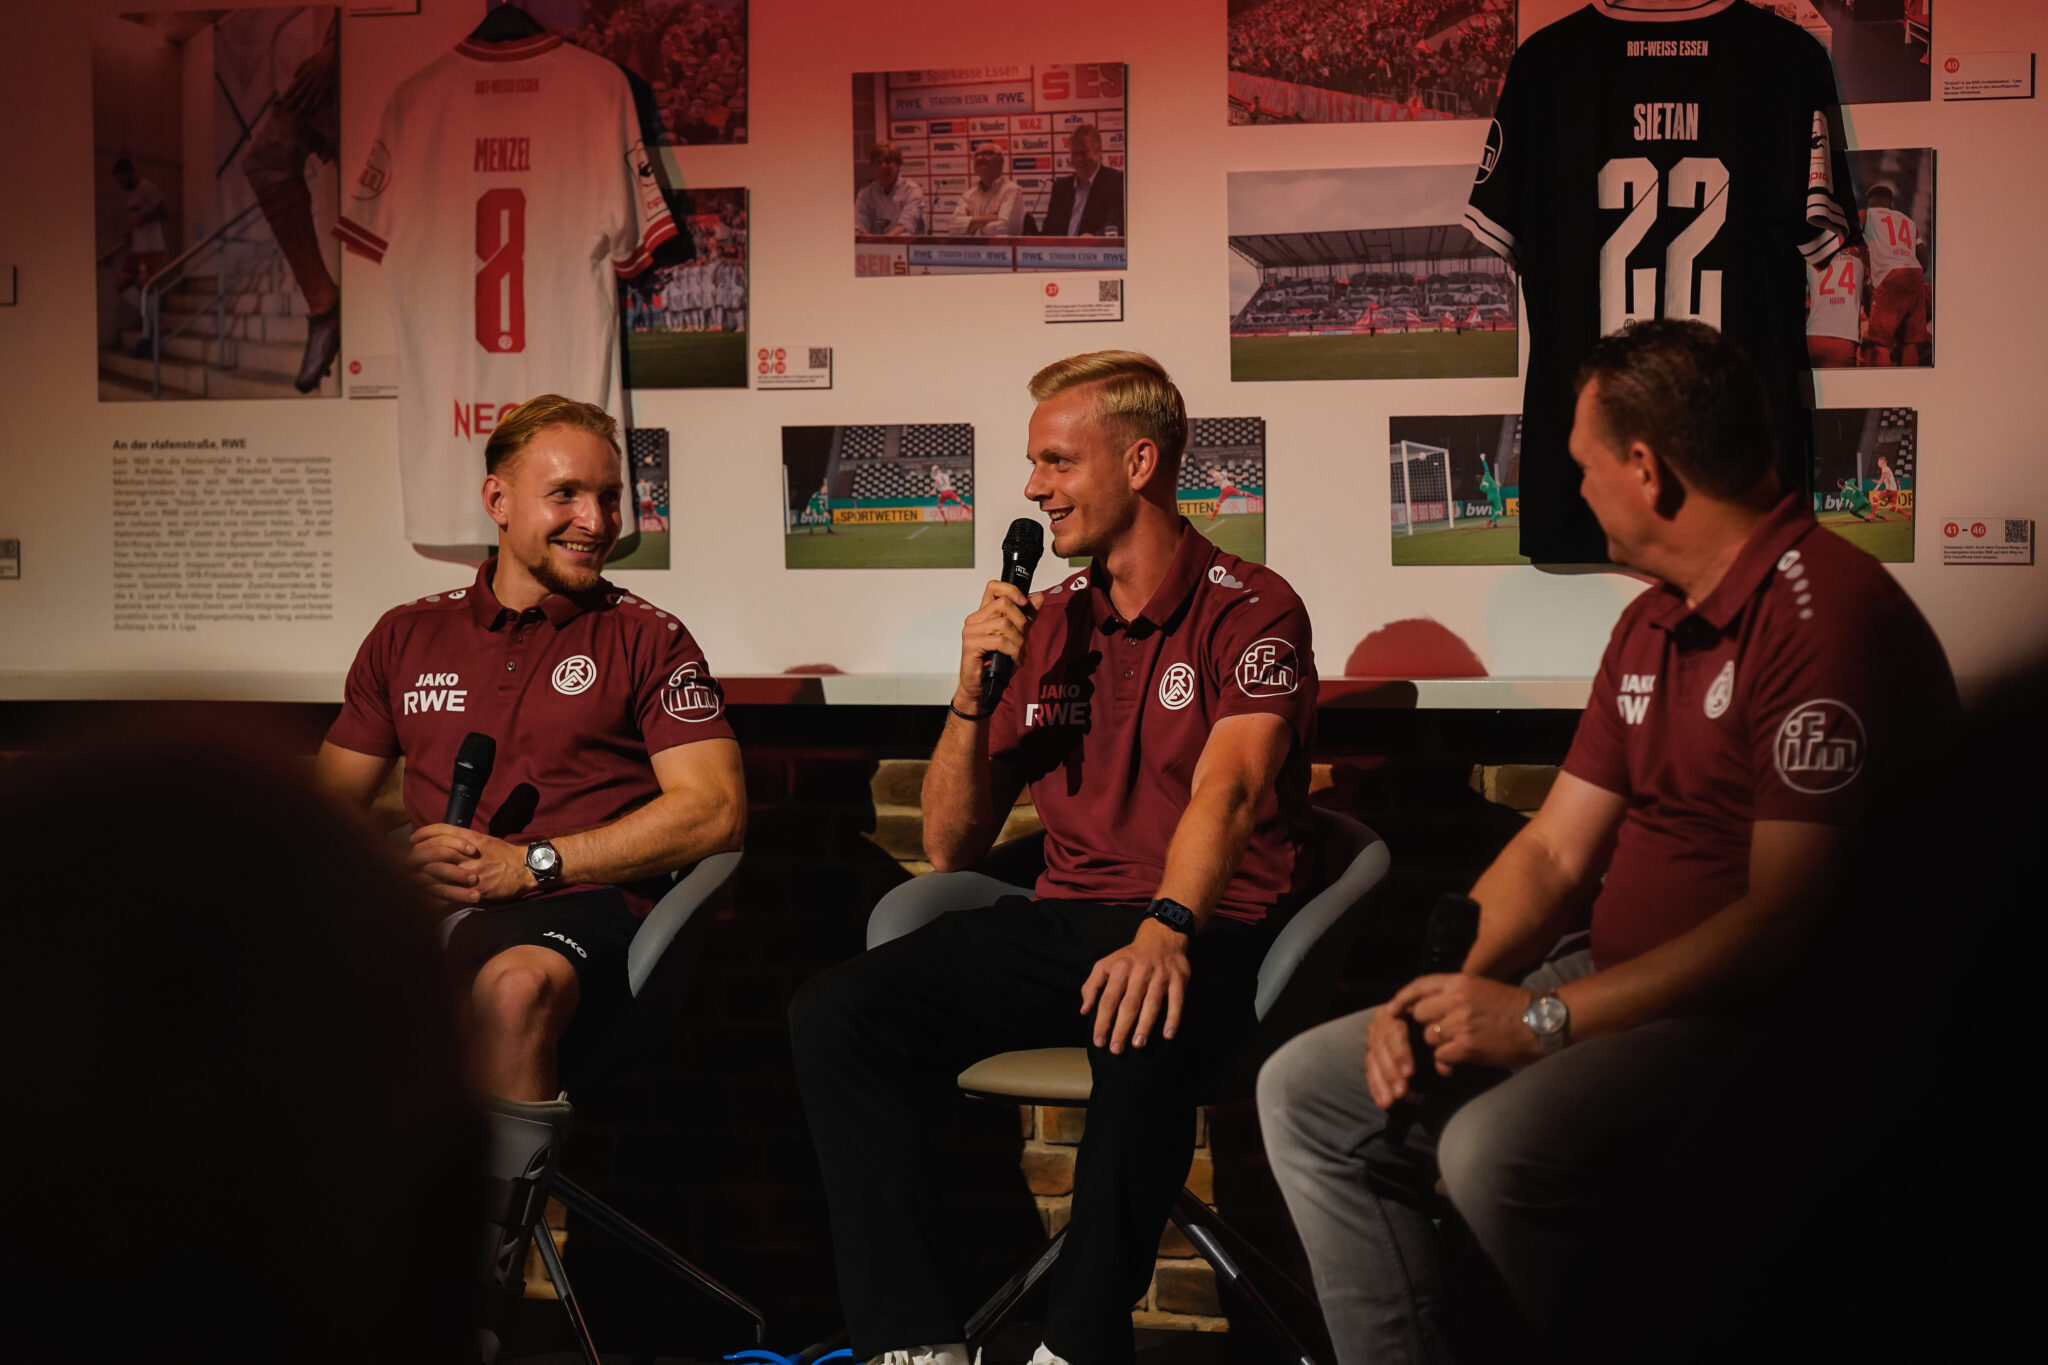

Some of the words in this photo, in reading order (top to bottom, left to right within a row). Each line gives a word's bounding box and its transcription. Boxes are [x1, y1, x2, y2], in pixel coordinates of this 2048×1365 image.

[1626, 40, 1678, 57] ROT-WEISS
[1679, 40, 1708, 57] ESSEN
[996, 91, 1025, 104] RWE
[1018, 117, 1043, 130] WAZ
[1632, 101, 1699, 142] SIETAN
[473, 136, 531, 172] MENZEL
[1881, 215, 1913, 250] 14
[1596, 157, 1730, 337] 22
[474, 187, 526, 353] 8
[1816, 261, 1856, 296] 24
[113, 439, 128, 450] An
[221, 438, 247, 449] RWE
[415, 672, 459, 687] JAKO
[1040, 684, 1081, 699] JAKO
[403, 689, 468, 716] RWE
[1025, 702, 1088, 727] RWE
[542, 931, 588, 959] JAKO
